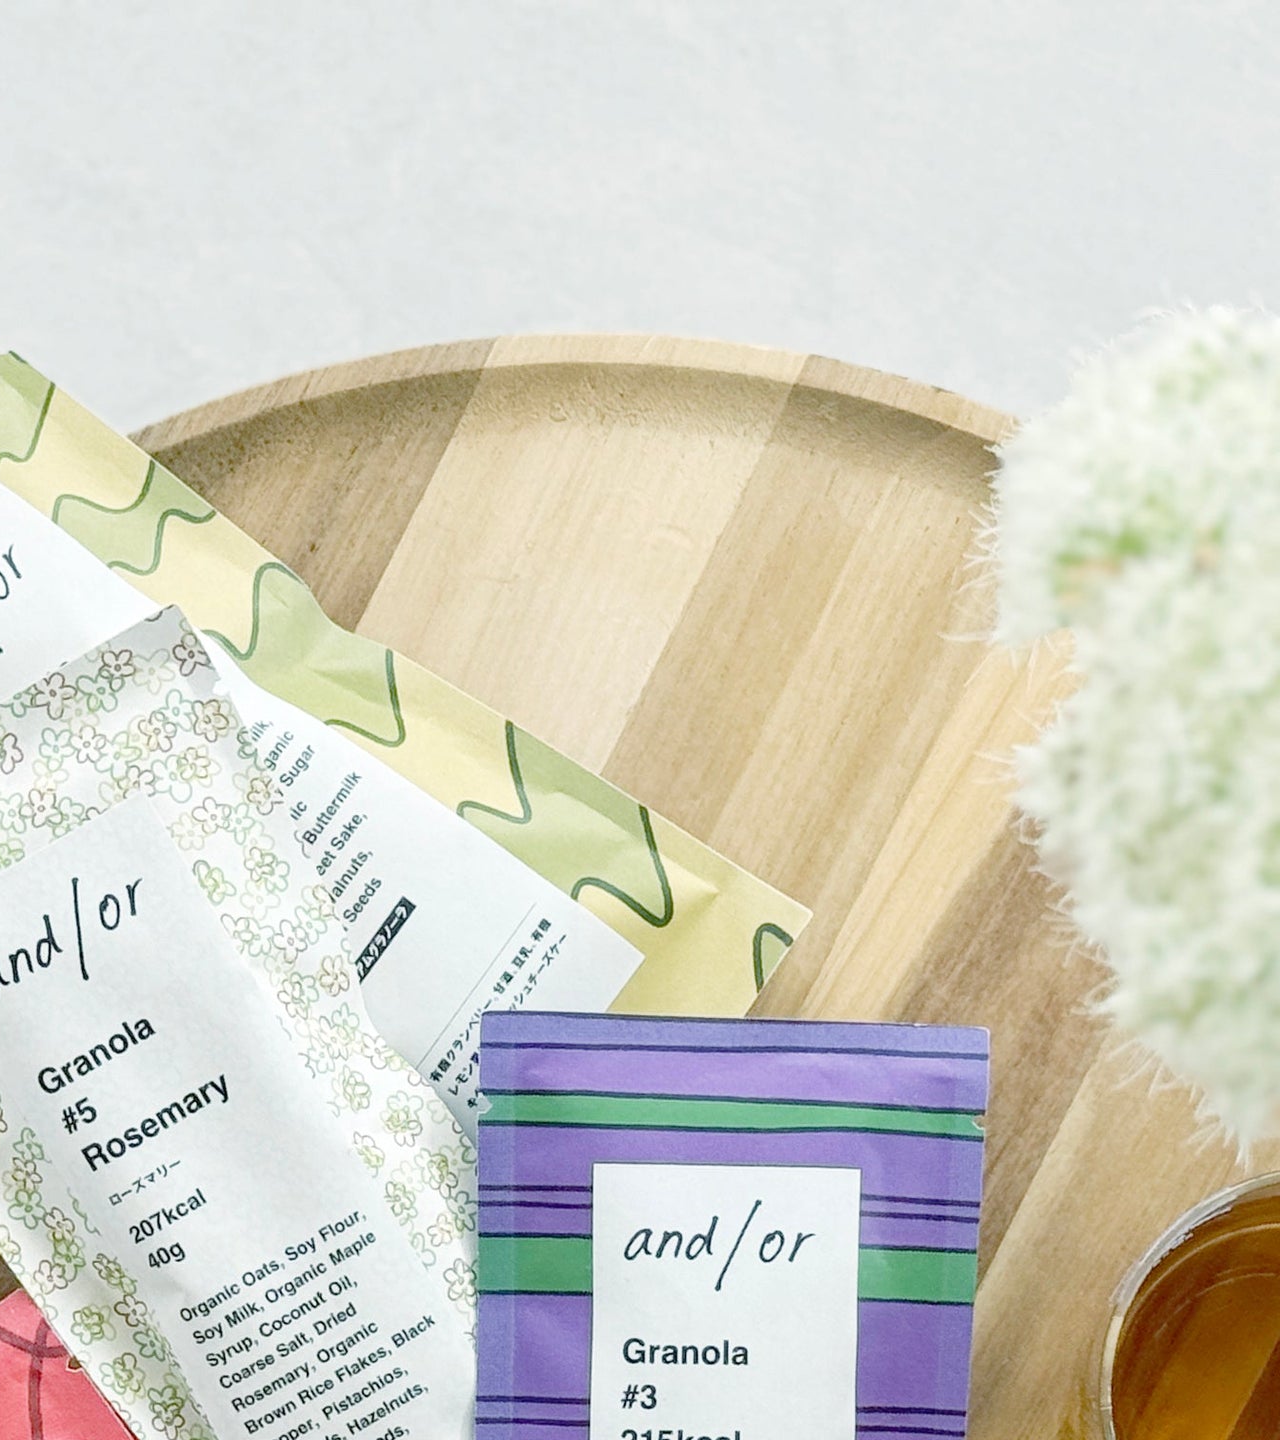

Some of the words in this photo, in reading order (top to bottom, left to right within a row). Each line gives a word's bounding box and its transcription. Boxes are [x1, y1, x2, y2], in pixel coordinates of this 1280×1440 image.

[251, 719, 274, 743] ilk,
[264, 730, 294, 772] ganic
[279, 745, 315, 787] Sugar
[302, 772, 362, 845] Buttermilk
[316, 850, 337, 877] eet
[330, 815, 367, 851] Sake,
[329, 851, 374, 904] alnuts,
[343, 878, 381, 923] Seeds
[38, 1019, 156, 1094] Granola
[61, 1097, 97, 1134] #5
[81, 1074, 229, 1172] Rosemary
[129, 1188, 207, 1244] 207kcal
[148, 1242, 186, 1268] 40g
[180, 1284, 240, 1322] Organic
[242, 1260, 285, 1287] Oats,
[285, 1237, 316, 1261] Soy
[318, 1211, 366, 1242] Flour,
[623, 1199, 816, 1292] and/or
[193, 1322, 223, 1344] Soy
[224, 1302, 265, 1328] Milk,
[265, 1263, 327, 1303] Organic
[328, 1232, 376, 1266] Maple
[206, 1337, 259, 1367] Syrup,
[259, 1291, 327, 1337] Coconut
[328, 1275, 358, 1296] Oil,
[219, 1354, 275, 1389] Coarse
[276, 1332, 314, 1357] Salt,
[312, 1302, 357, 1336] Dried
[231, 1362, 316, 1413] Rosemary,
[316, 1322, 378, 1363] Organic
[244, 1400, 297, 1434] Brown
[297, 1379, 334, 1405] Rice
[334, 1347, 392, 1383] Flakes,
[391, 1315, 435, 1348] Black
[623, 1338, 748, 1366] Granola
[321, 1367, 408, 1421] Pistachios,
[346, 1384, 428, 1436] Hazelnuts,
[621, 1384, 657, 1410] #3
